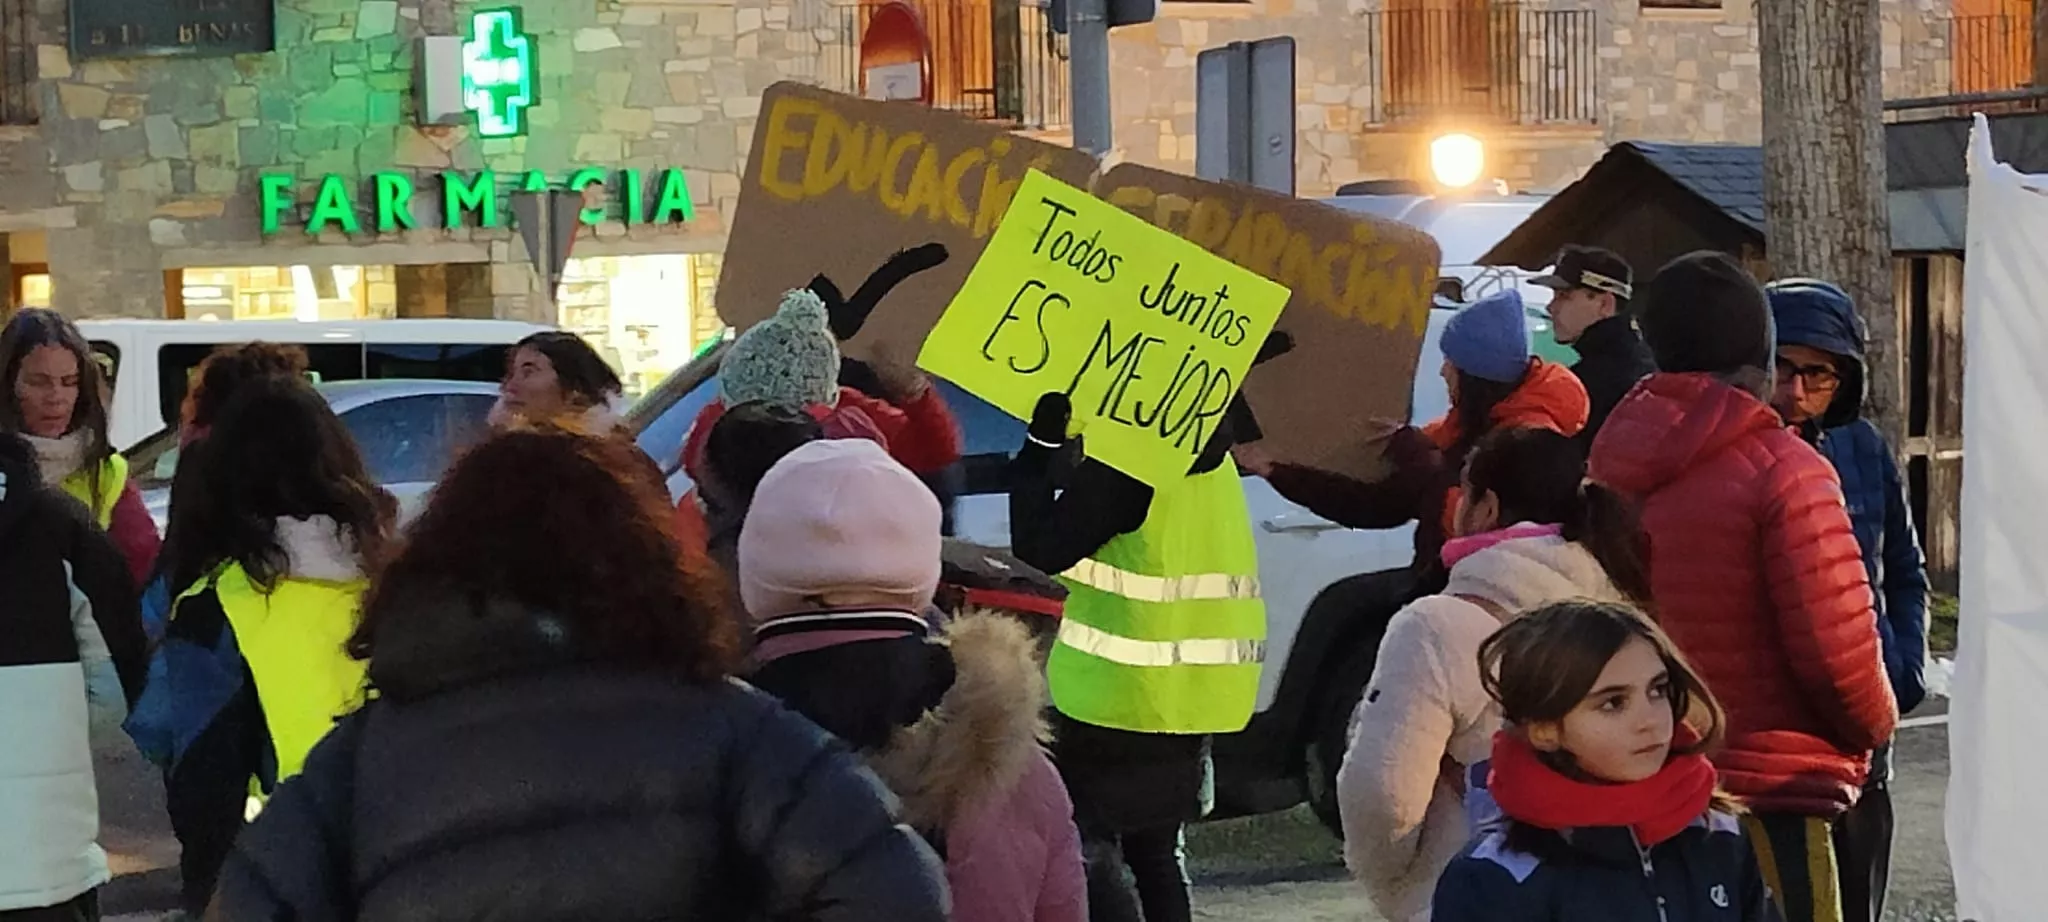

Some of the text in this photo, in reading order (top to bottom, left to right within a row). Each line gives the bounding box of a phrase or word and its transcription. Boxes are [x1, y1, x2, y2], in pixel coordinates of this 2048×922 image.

[760, 96, 1053, 239] EDUCACI
[1031, 197, 1251, 346] Todos Juntos
[980, 280, 1231, 455] ES MEJOR
